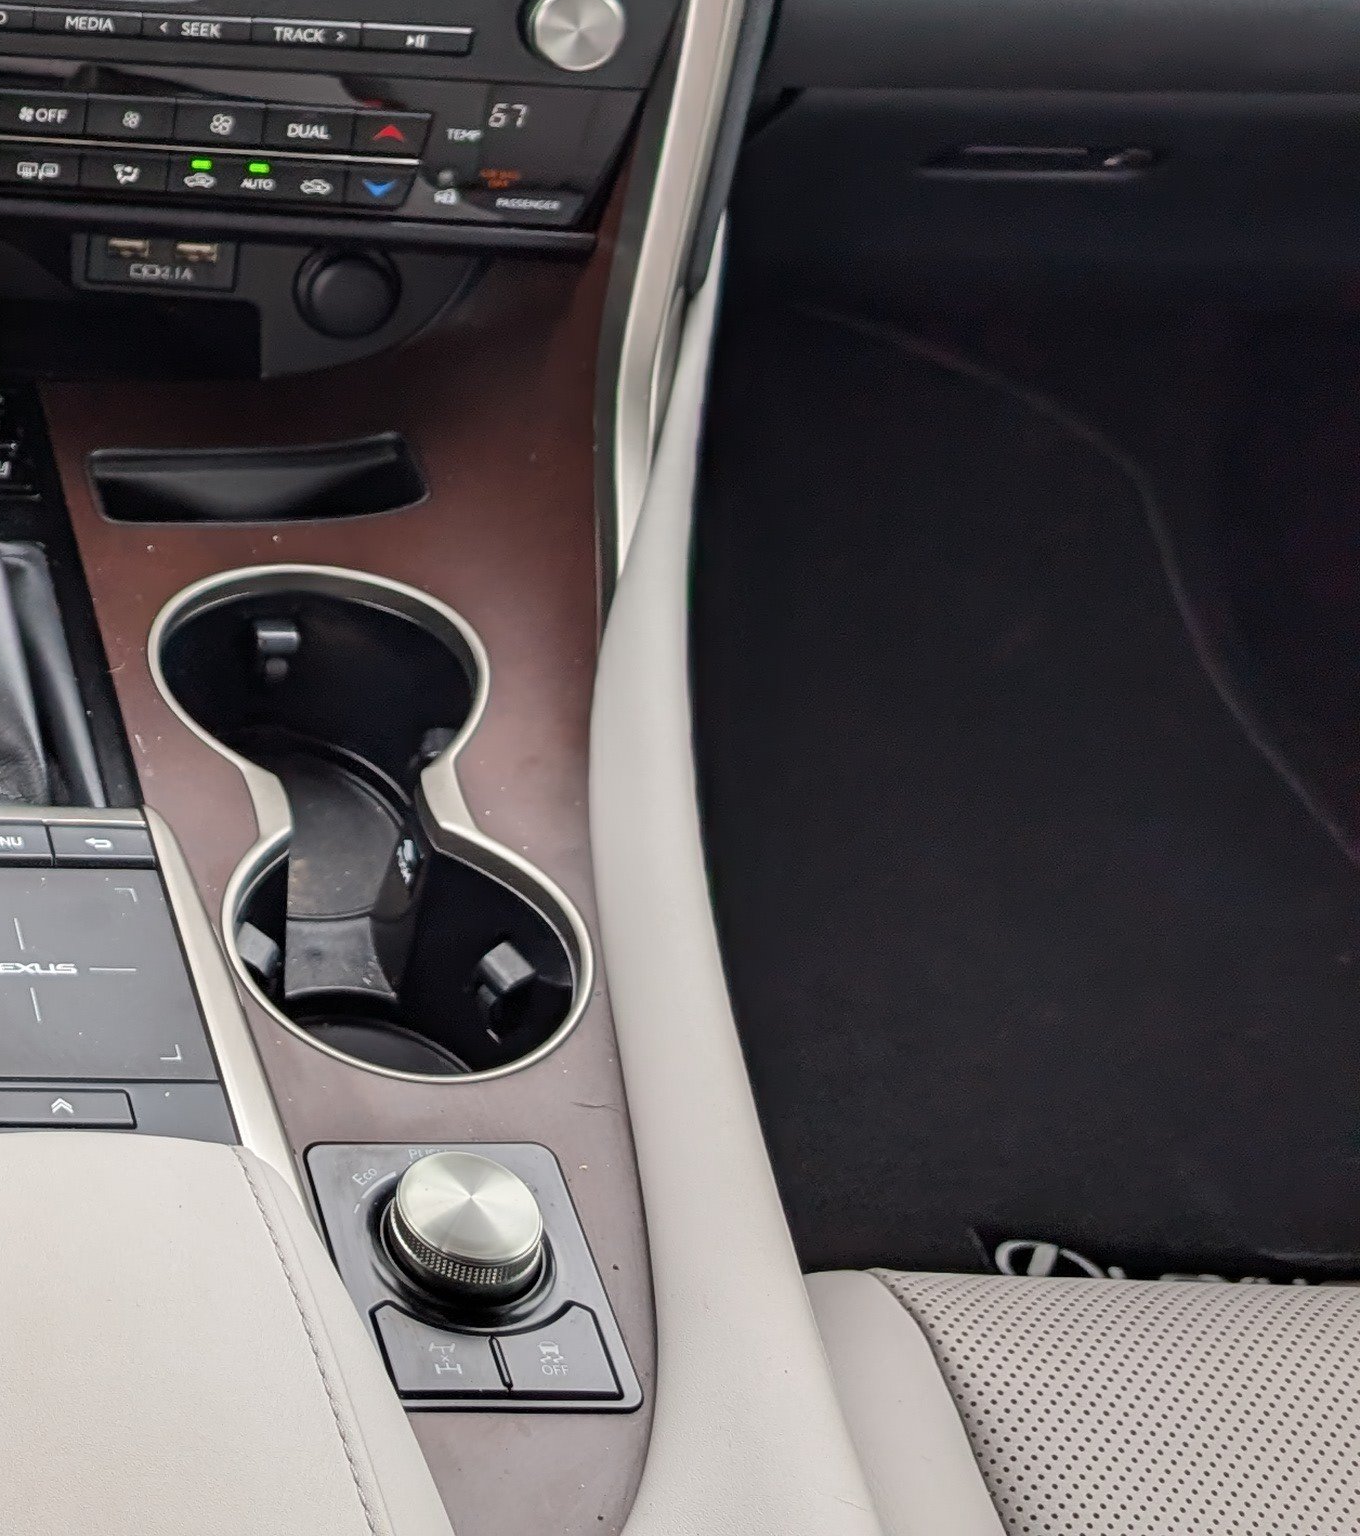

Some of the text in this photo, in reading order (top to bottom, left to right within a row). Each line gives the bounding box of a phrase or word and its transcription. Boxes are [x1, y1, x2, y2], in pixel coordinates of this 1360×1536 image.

[65, 14, 115, 32] MEDIA
[180, 21, 223, 39] SEEK
[273, 26, 325, 43] TRACK
[35, 107, 69, 124] OFF
[488, 103, 528, 128] 67
[286, 123, 331, 140] DUAL
[447, 128, 482, 142] TEMP
[240, 179, 275, 192] AUTO
[495, 197, 562, 211] PASSENGER
[352, 1167, 378, 1187] Eco
[540, 1363, 570, 1376] OFF
